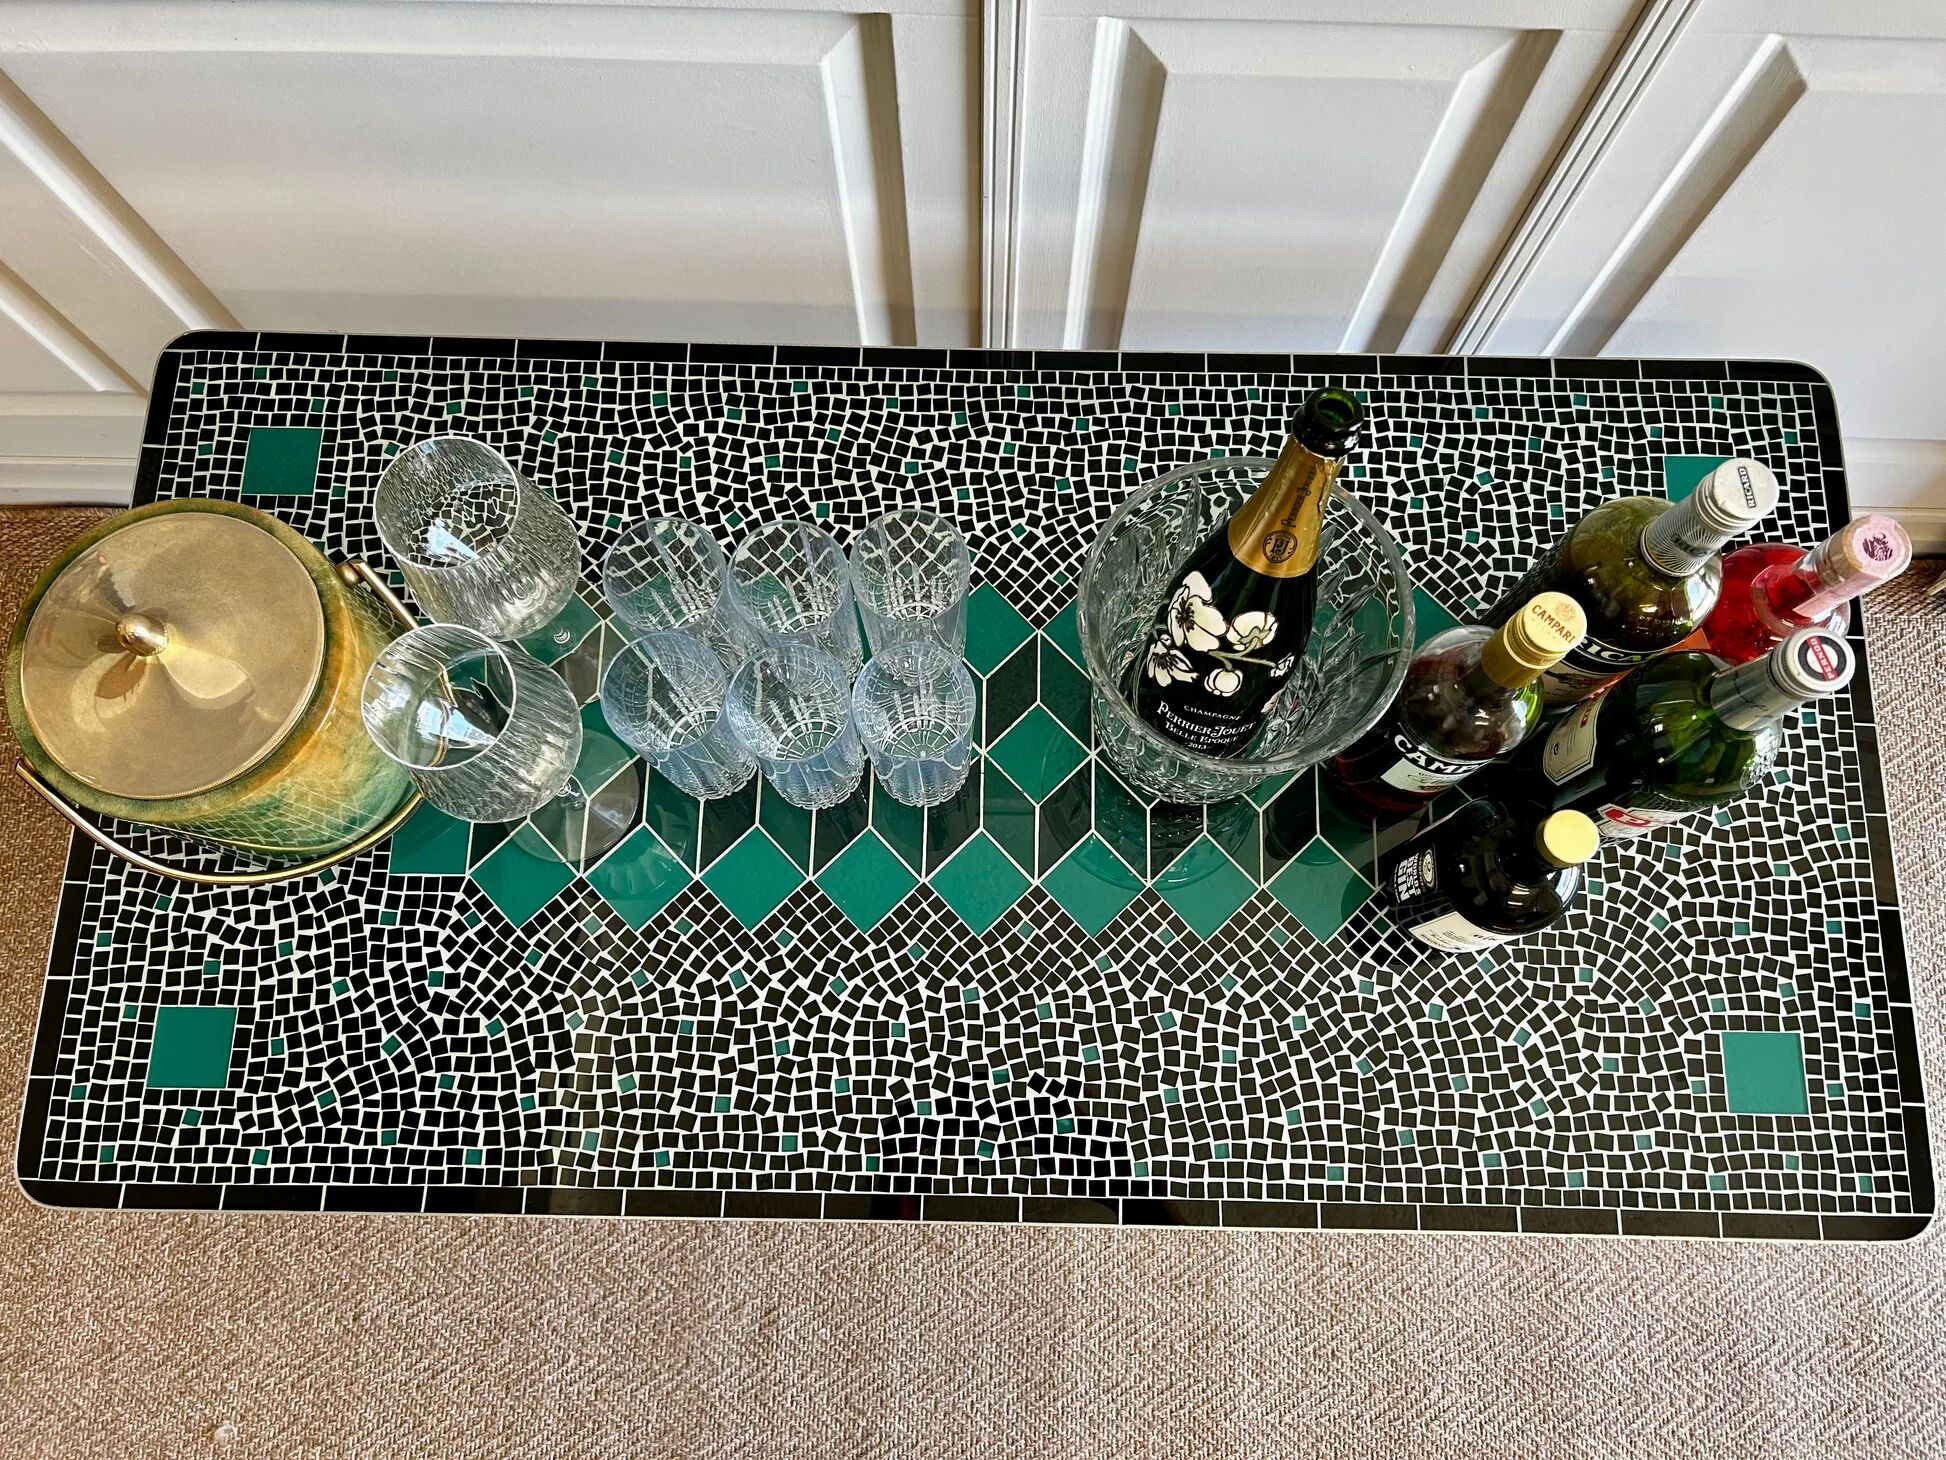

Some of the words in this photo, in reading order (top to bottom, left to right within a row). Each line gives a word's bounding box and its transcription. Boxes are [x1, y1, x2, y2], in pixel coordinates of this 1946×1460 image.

[1738, 466, 1756, 508] RICARD
[1531, 604, 1576, 643] CAMPARI
[1810, 637, 1835, 679] PERNOD
[1165, 720, 1197, 741] BELLE
[1183, 705, 1242, 721] CHAMPAGNE
[1397, 859, 1410, 902] GIN
[1406, 855, 1416, 896] BEST
